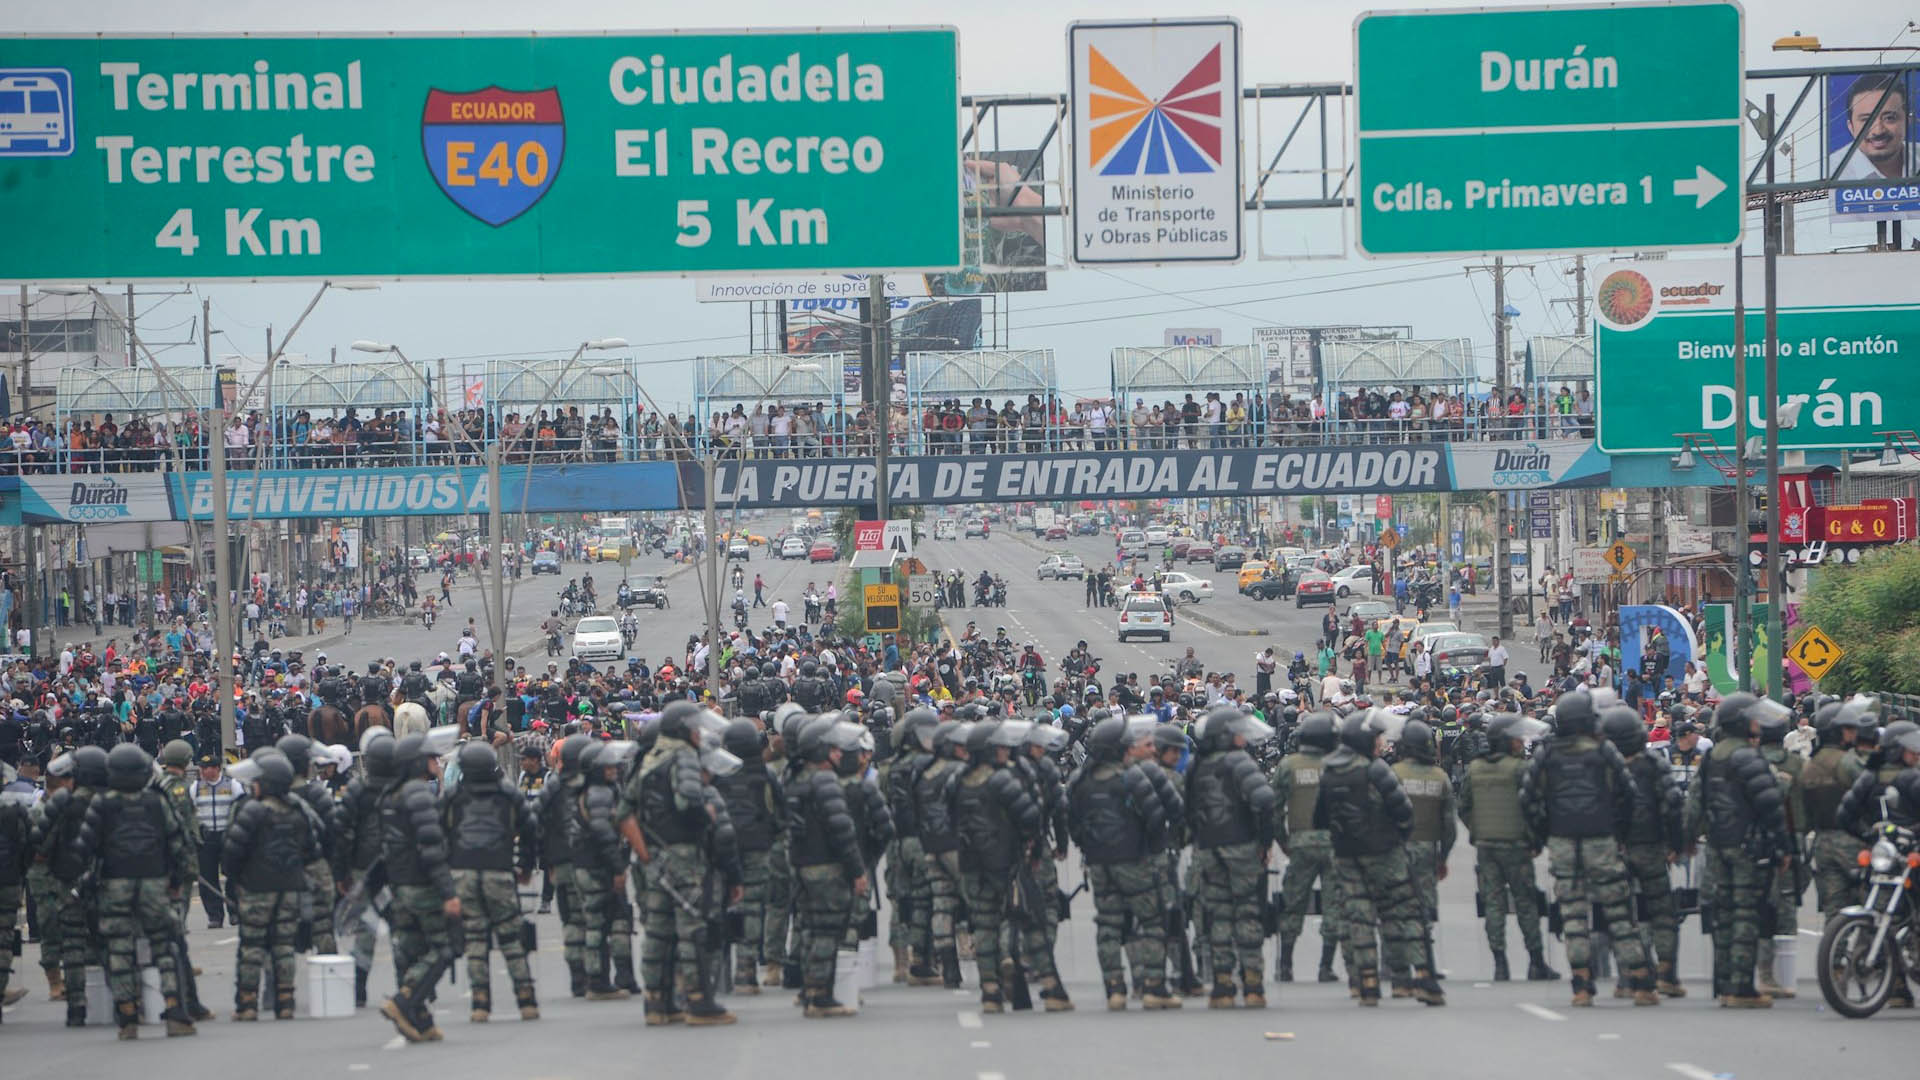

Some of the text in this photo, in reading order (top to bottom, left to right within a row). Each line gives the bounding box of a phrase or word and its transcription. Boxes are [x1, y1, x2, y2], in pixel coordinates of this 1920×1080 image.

[101, 60, 363, 111] Terminal
[609, 52, 884, 106] Ciudadela
[1481, 45, 1618, 92] Durán
[451, 102, 536, 120] ECUADOR
[95, 133, 375, 184] Terrestre
[447, 141, 549, 187] E40
[615, 127, 884, 177] El Recreo
[1112, 184, 1194, 201] Ministerio
[1373, 175, 1653, 212] Cdla. Primavera 1
[1842, 187, 1885, 202] GALO
[155, 207, 321, 256] 4 Km
[675, 198, 828, 247] 5 Km
[1098, 205, 1216, 225] de Transporte
[1084, 227, 1229, 248] y Obras Públicas
[711, 283, 793, 297] Innovación
[797, 281, 817, 294] de
[1660, 282, 1725, 298] ecuador
[1798, 338, 1817, 356] al
[1823, 335, 1899, 356] Cantón
[191, 472, 490, 515] BIENVENIDOS A
[714, 467, 759, 503] LA
[932, 461, 988, 499] DE
[997, 457, 1179, 497] ENTRADA
[1187, 454, 1239, 491] AL
[1251, 449, 1440, 490] ECUADOR
[1830, 519, 1886, 537] G & Q
[911, 591, 932, 603] 50
